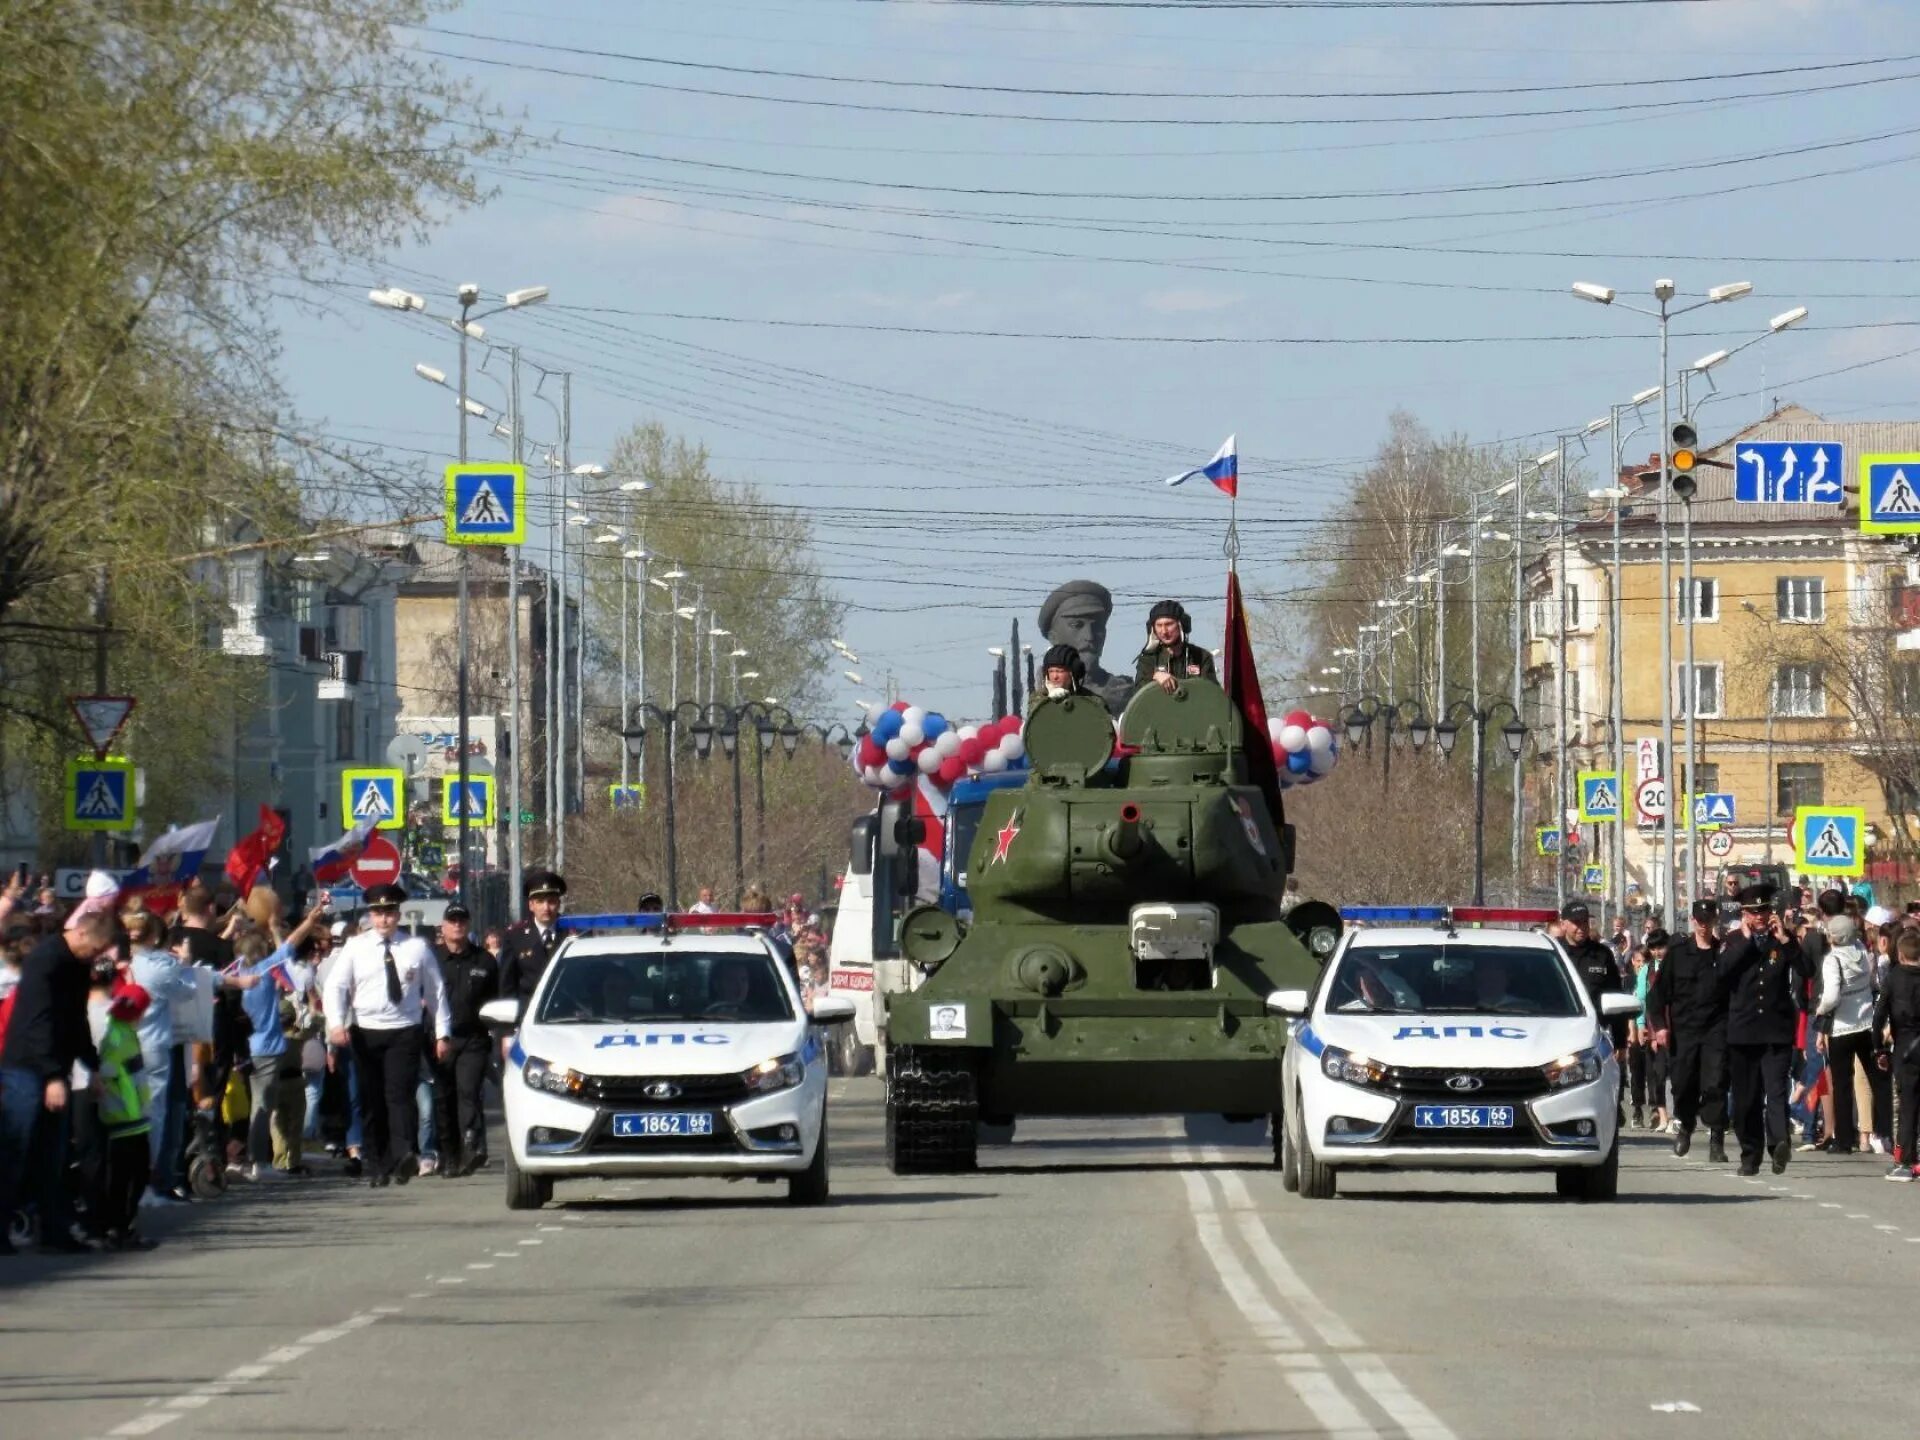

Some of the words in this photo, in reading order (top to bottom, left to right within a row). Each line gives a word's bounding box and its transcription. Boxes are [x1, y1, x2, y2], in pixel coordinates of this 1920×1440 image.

[1645, 790, 1666, 807] 20
[1713, 838, 1728, 849] 20
[594, 1033, 731, 1049] ДПС
[1393, 1026, 1529, 1040] ДПС
[640, 1116, 680, 1133] 1862
[690, 1115, 706, 1127] 66
[1441, 1108, 1480, 1125] 1856
[1490, 1108, 1507, 1121] 66
